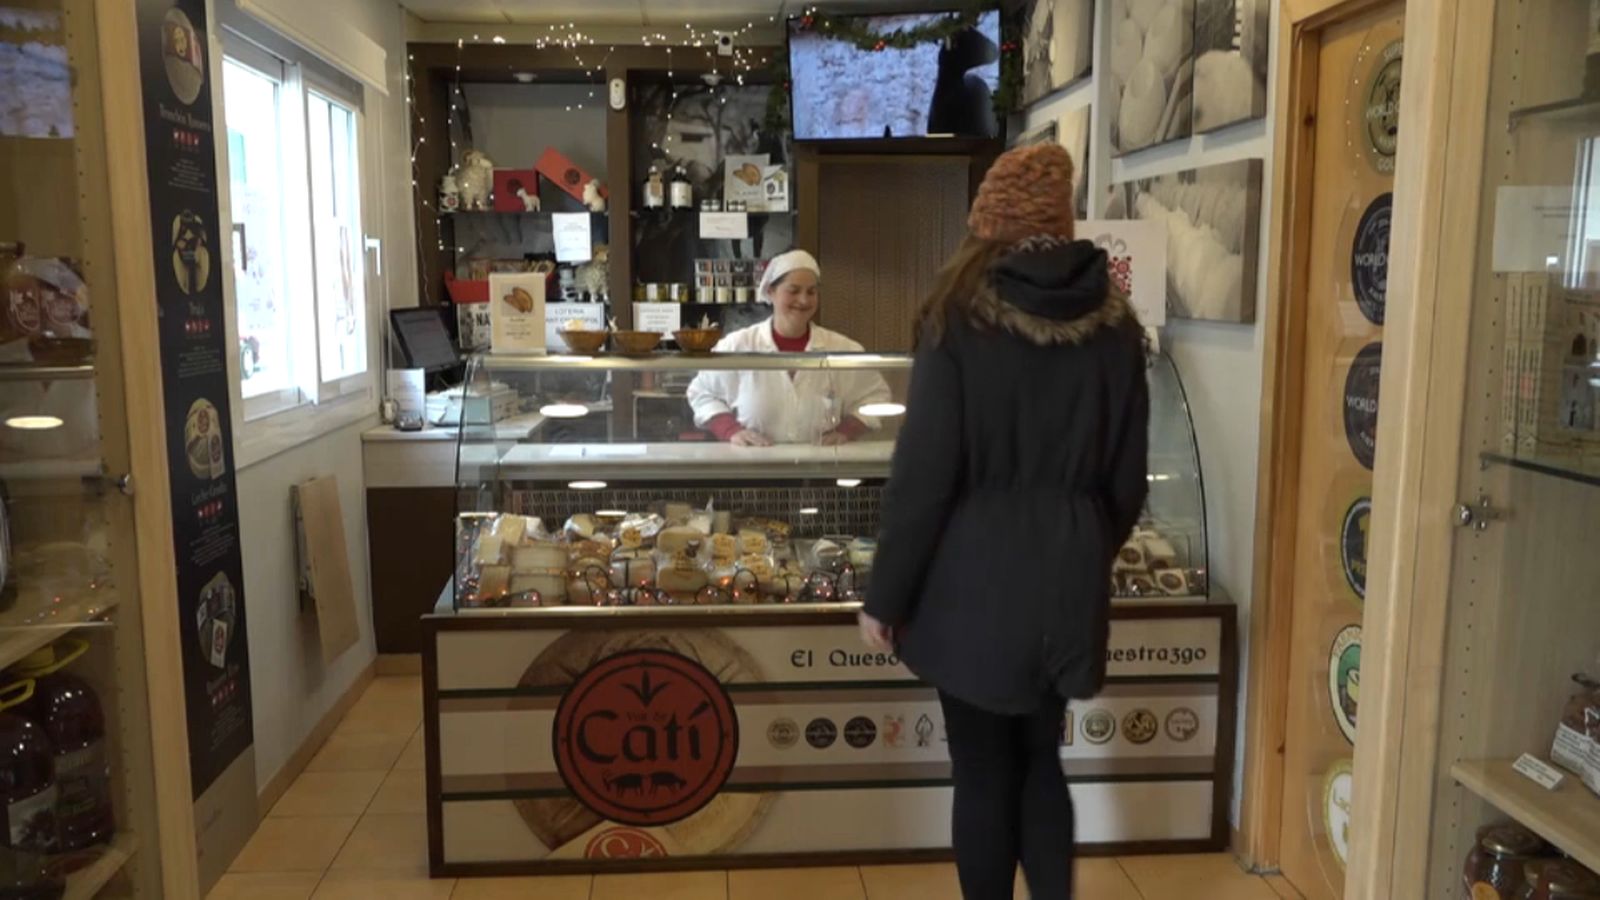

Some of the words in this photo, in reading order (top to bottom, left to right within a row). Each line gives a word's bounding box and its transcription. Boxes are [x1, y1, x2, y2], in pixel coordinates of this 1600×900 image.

[1354, 253, 1386, 267] WORLD
[1346, 396, 1377, 413] WORLD
[790, 648, 813, 668] El
[828, 649, 900, 667] Queso
[576, 700, 711, 765] Catí
